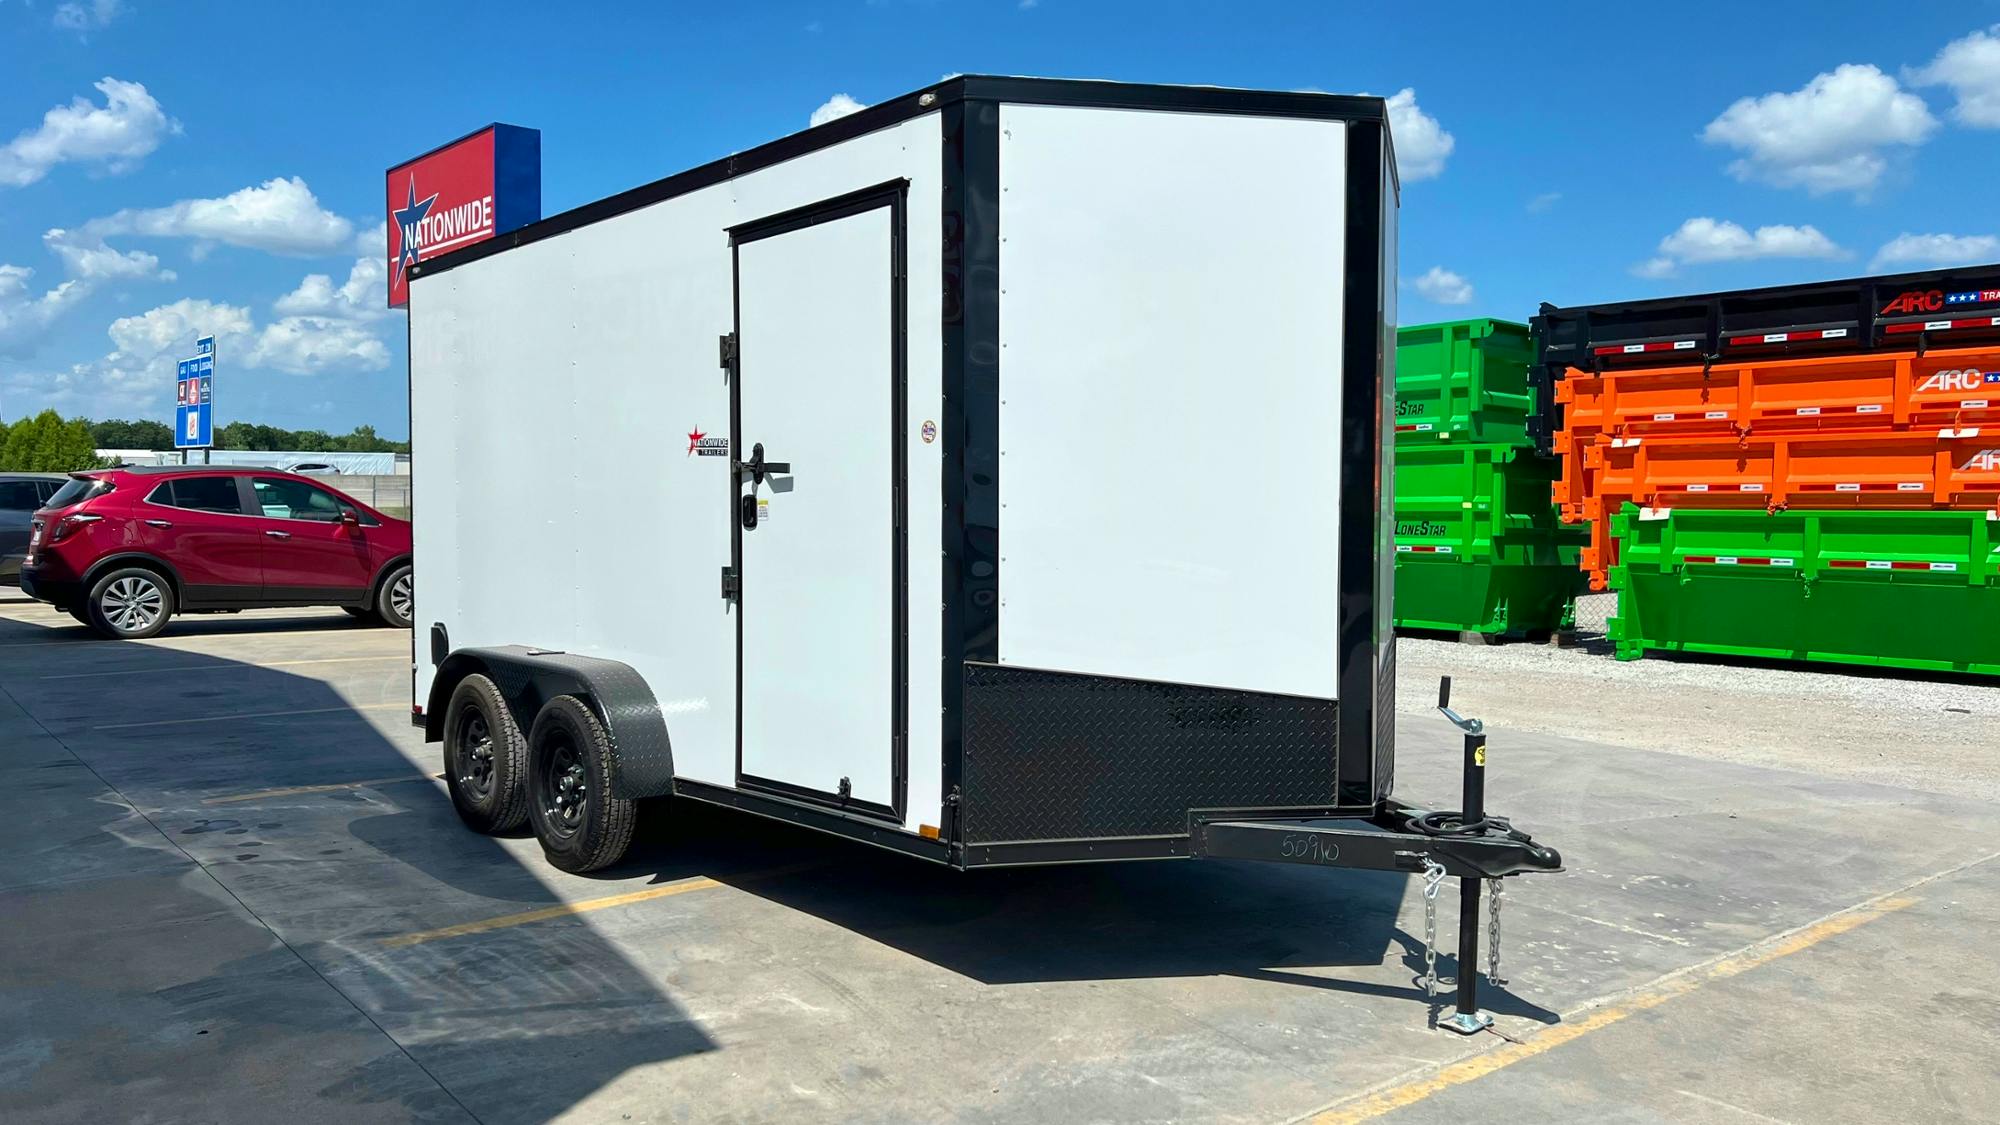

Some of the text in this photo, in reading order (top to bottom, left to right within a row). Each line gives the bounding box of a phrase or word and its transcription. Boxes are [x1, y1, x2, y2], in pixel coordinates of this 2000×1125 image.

[404, 195, 492, 251] NATIONWIDE
[1880, 289, 1943, 314] ARC
[1917, 368, 1981, 392] ARC
[692, 437, 728, 447] NATIONWIDE
